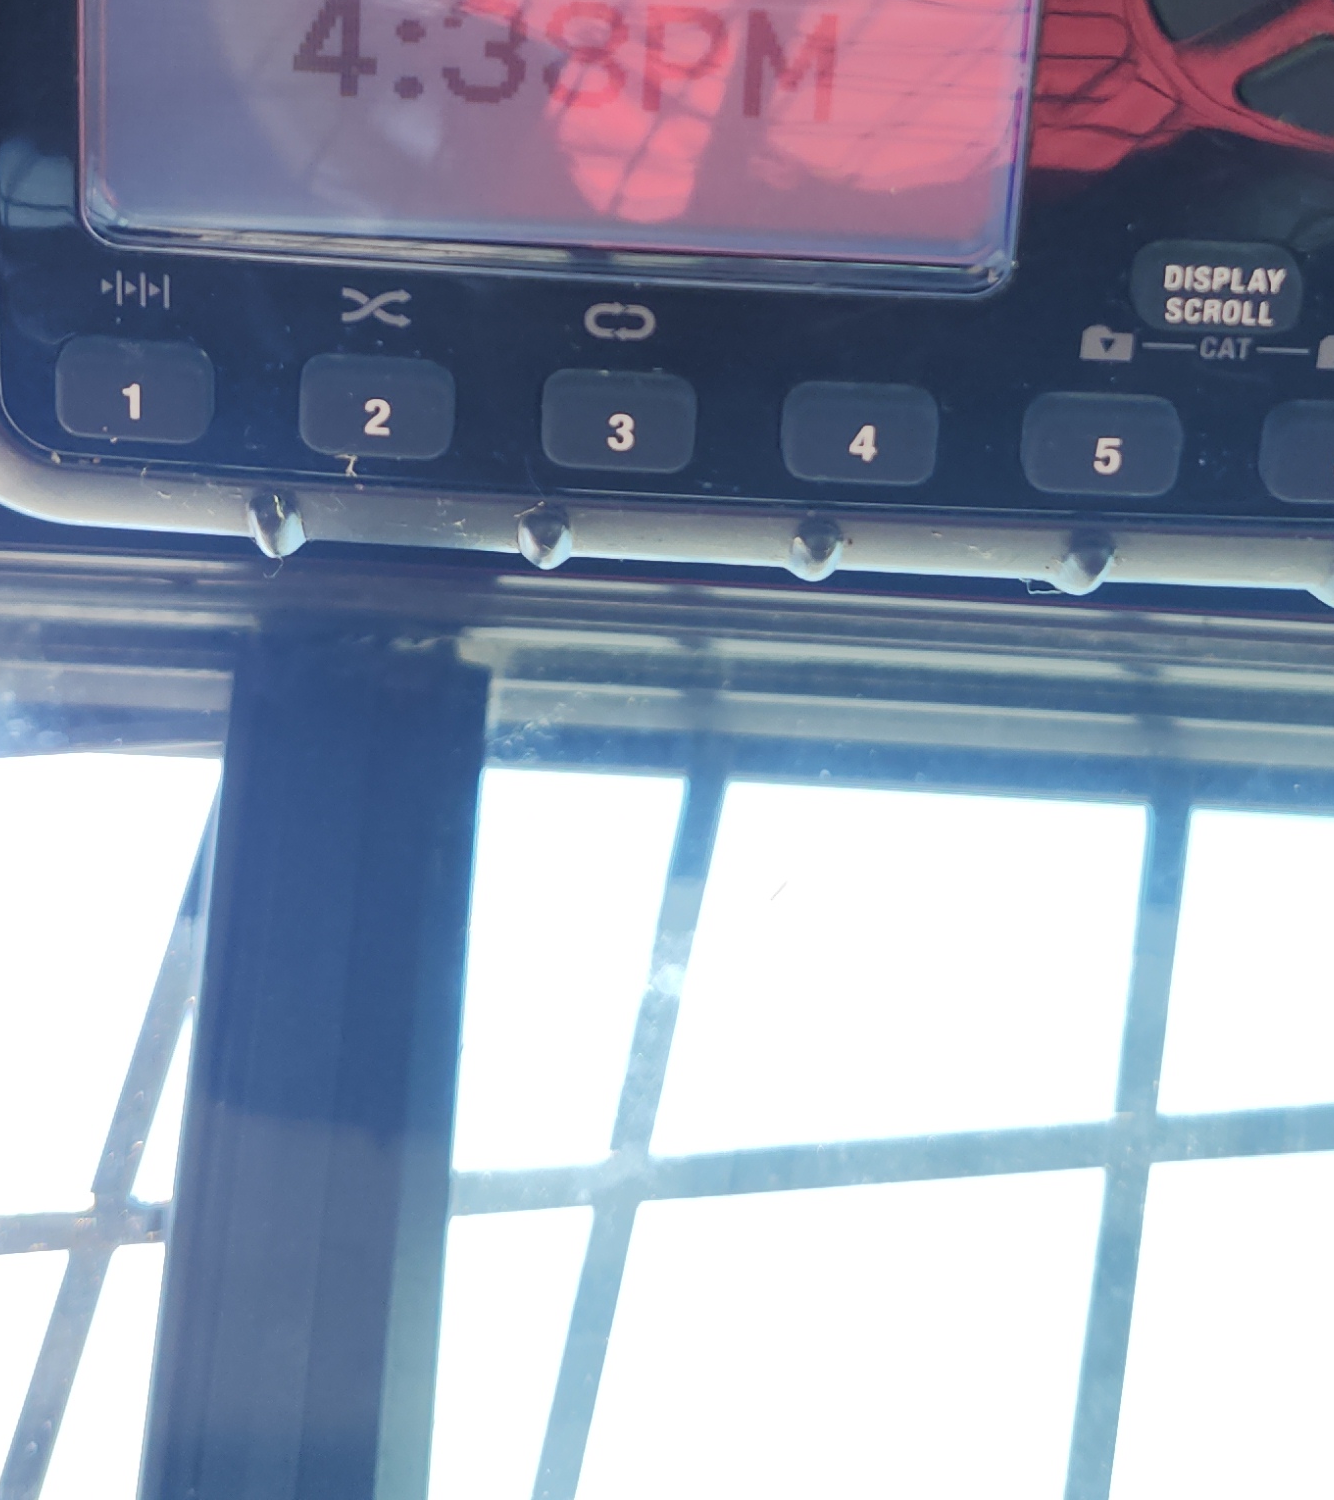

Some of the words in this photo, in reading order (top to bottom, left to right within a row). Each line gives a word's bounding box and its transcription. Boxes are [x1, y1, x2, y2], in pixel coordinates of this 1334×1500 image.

[1163, 264, 1287, 295] DISPLAY
[1164, 296, 1275, 328] SCROLL
[1199, 335, 1254, 362] CAT
[121, 383, 142, 421] 1
[364, 398, 392, 437] 2
[607, 413, 637, 453] 3
[849, 424, 878, 463] 4
[1093, 438, 1123, 476] 5
